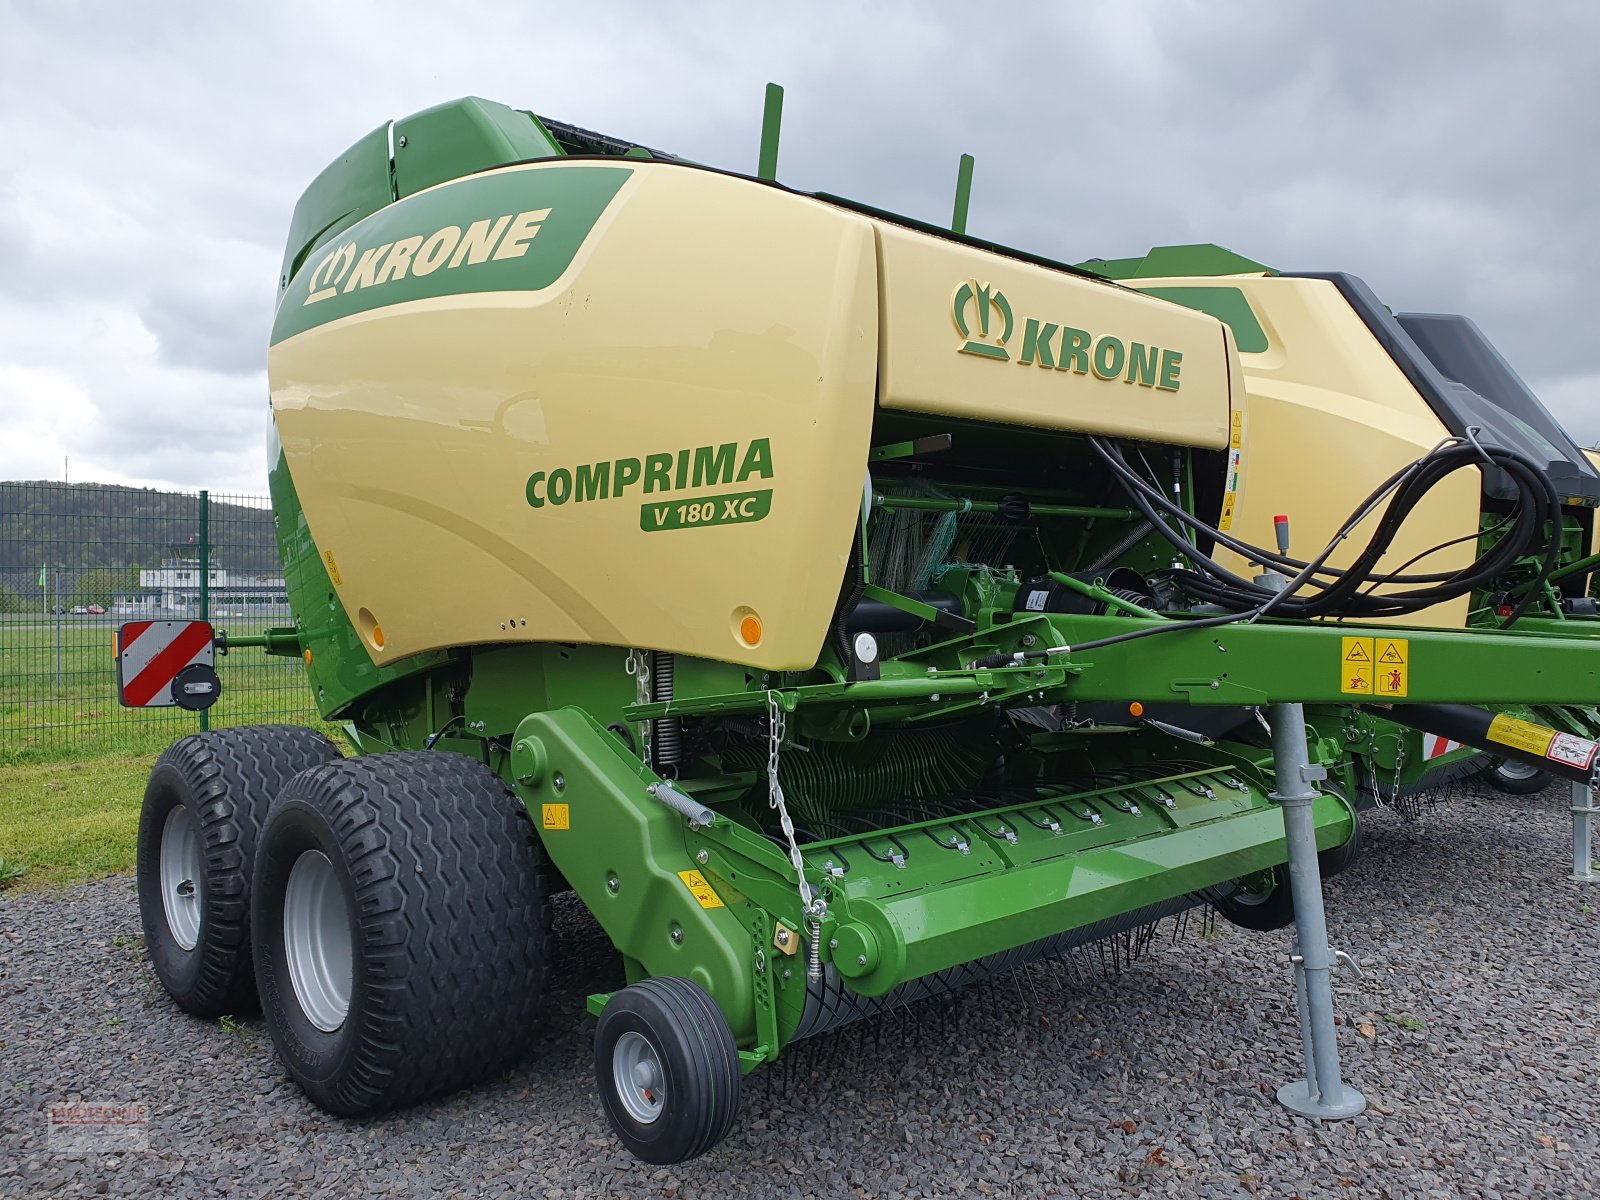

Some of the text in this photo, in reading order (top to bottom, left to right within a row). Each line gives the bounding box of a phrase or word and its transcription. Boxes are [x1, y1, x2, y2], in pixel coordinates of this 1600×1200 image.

[343, 208, 552, 293] KRONE
[1017, 317, 1183, 392] KRONE
[525, 437, 774, 508] COMPRIMA
[654, 497, 757, 526] V 180 XC
